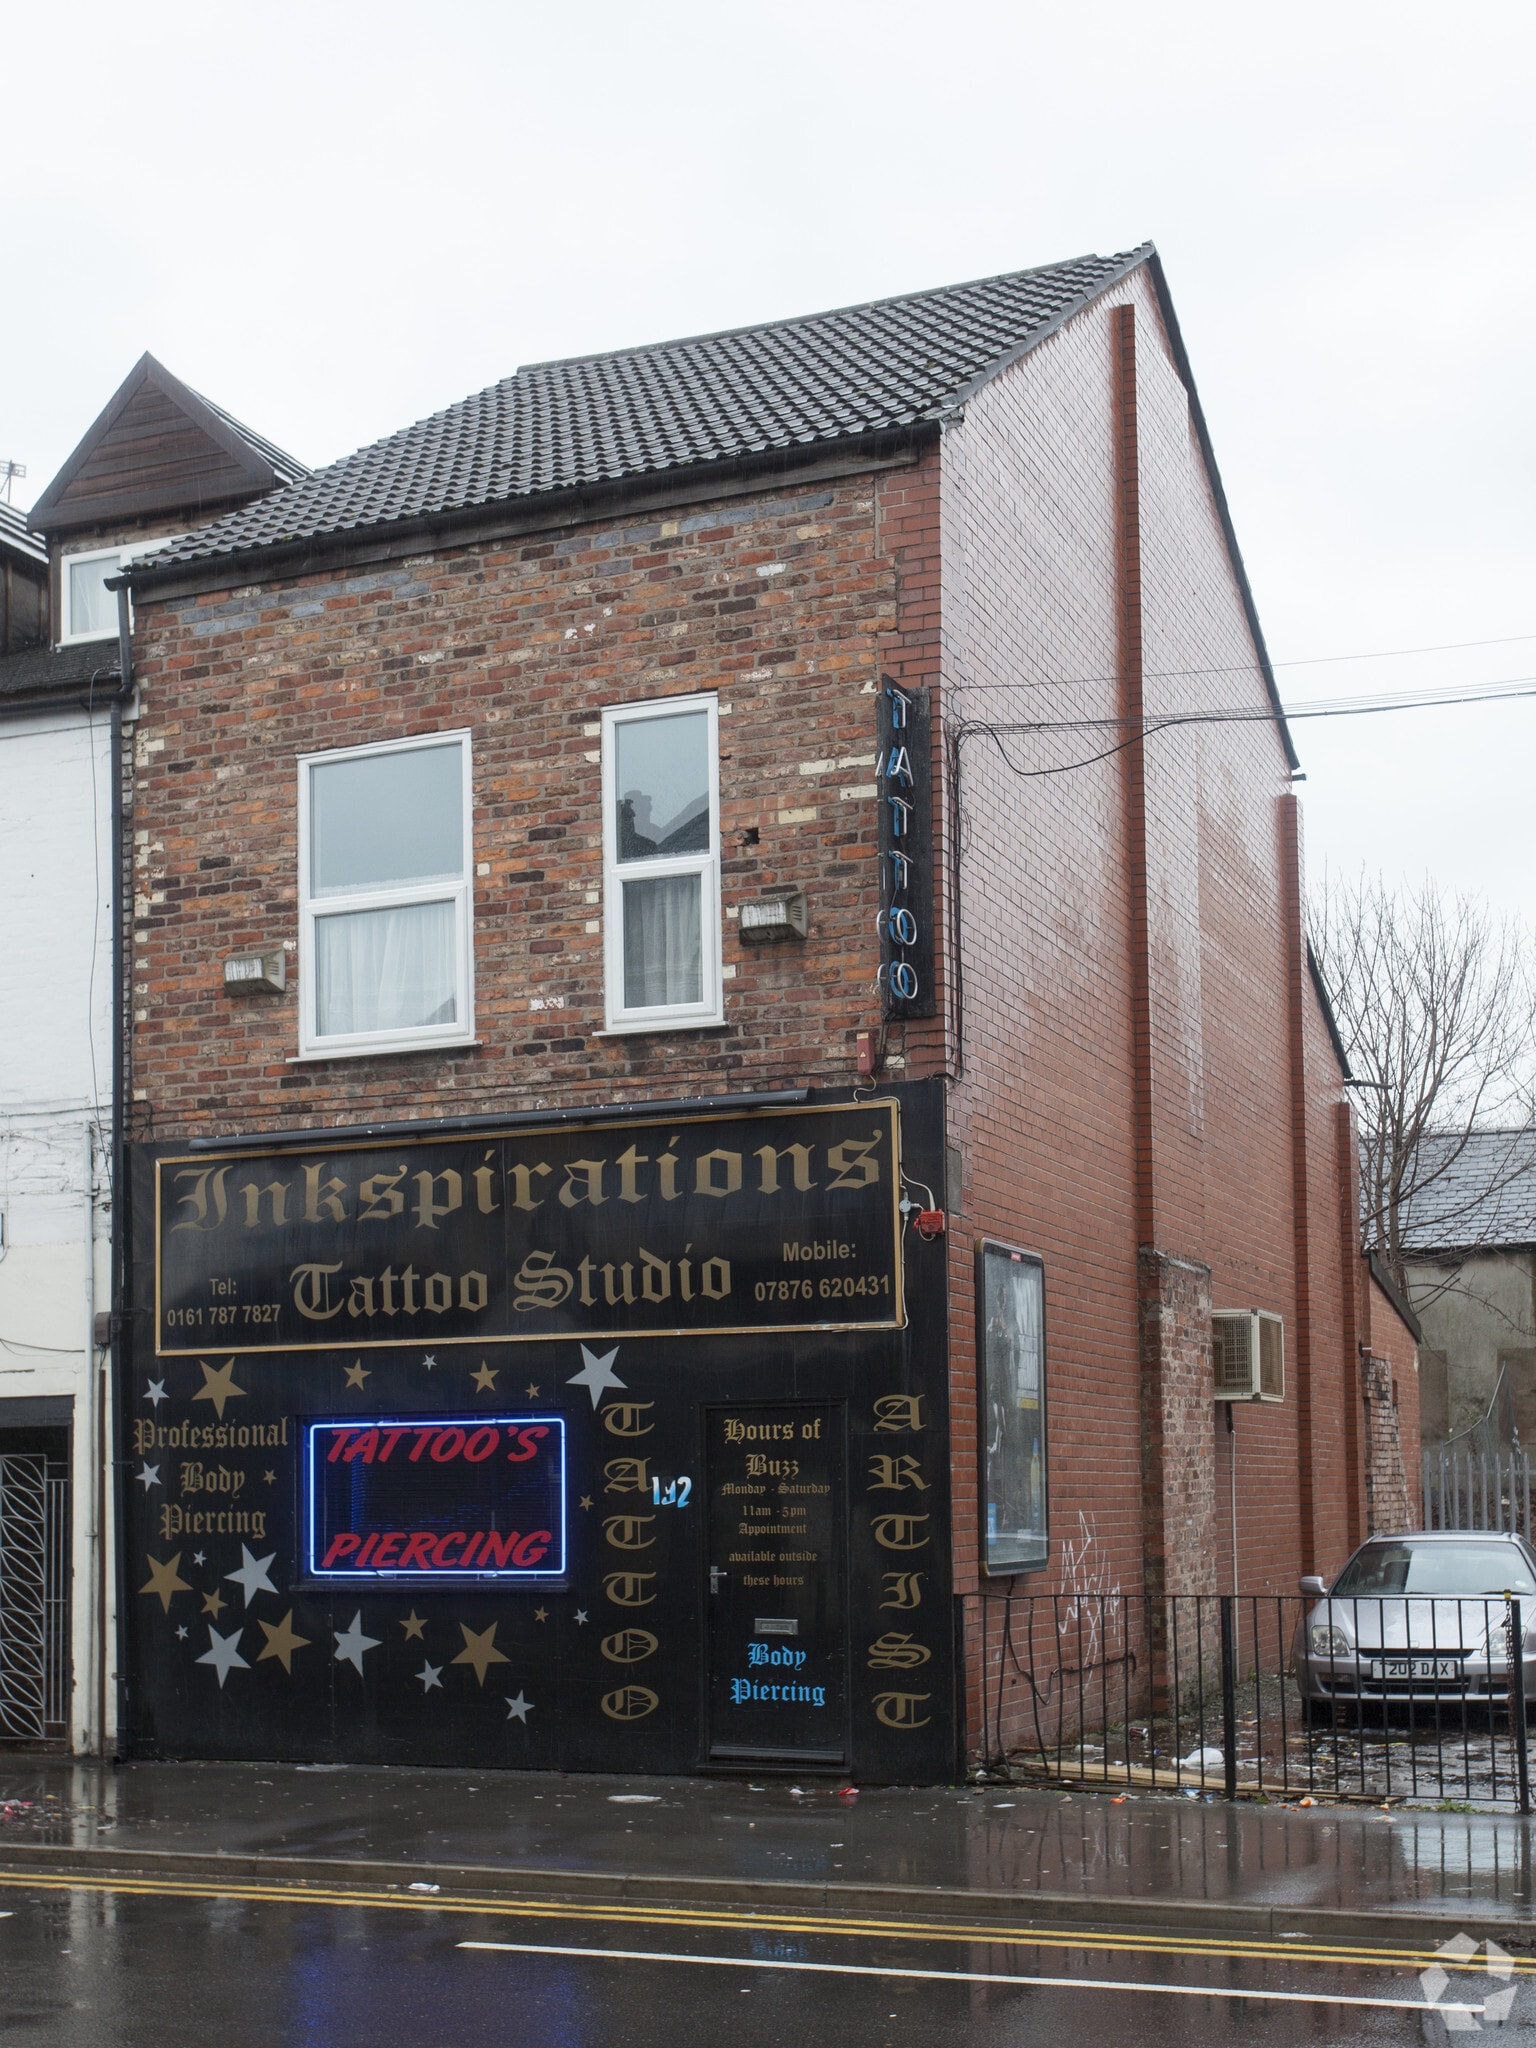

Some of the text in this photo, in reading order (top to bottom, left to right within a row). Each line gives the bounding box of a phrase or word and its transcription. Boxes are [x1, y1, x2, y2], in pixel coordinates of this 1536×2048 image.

[887, 687, 918, 999] TATTOO
[170, 1129, 883, 1233] Inkspirations
[783, 1239, 858, 1262] Mobile:
[208, 1277, 238, 1296] Tel:
[289, 1243, 732, 1320] Tattoo Studio
[754, 1274, 890, 1301] 07876 620431
[166, 1303, 281, 1327] 0161 787 7827
[132, 1416, 289, 1456] Professional
[327, 1426, 550, 1464] TATTOO'S
[723, 1418, 822, 1445] Hours of
[179, 1461, 246, 1499] Body
[745, 1453, 800, 1480] Buzz
[720, 1482, 767, 1496] Monday
[777, 1482, 831, 1496] Saturday
[159, 1503, 268, 1541] Piercing
[738, 1522, 808, 1536] Appointment
[321, 1530, 552, 1569] PIERCING
[601, 1401, 660, 1721] TATTOO
[728, 1550, 818, 1563] available outside
[866, 1394, 932, 1729] ARTIST
[743, 1574, 805, 1588] these hours
[747, 1643, 807, 1671] Body
[729, 1677, 826, 1707] Piercing
